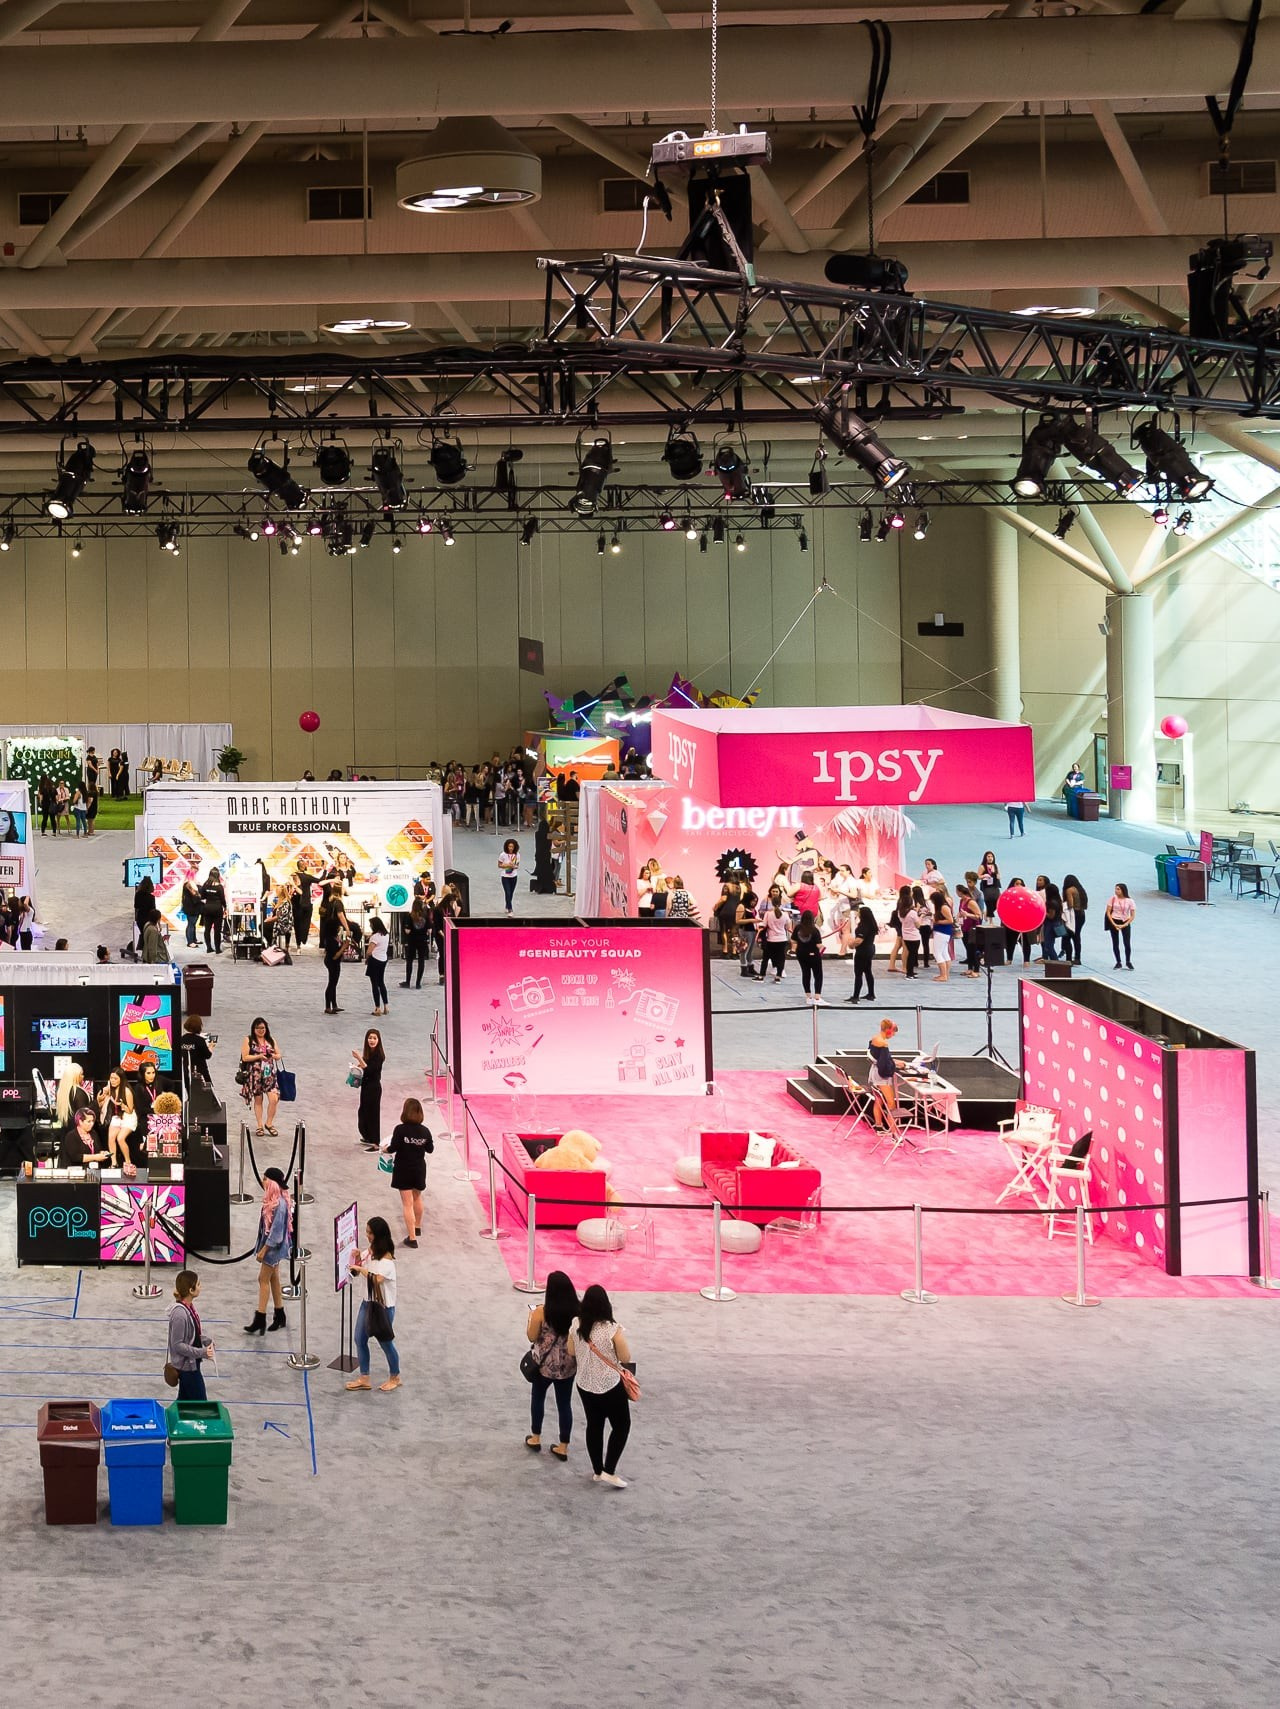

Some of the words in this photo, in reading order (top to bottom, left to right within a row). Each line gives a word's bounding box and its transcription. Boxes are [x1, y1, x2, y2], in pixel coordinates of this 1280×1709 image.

[15, 749, 72, 760] COVERGIRL
[668, 732, 697, 789] ipsy
[812, 748, 944, 802] ipsy
[227, 796, 269, 815] MARC
[280, 796, 350, 815] ANTHONY
[237, 823, 261, 831] TRUE
[266, 823, 342, 832] PROFESSIONAL
[549, 939, 577, 947] SNAP
[581, 939, 610, 947] YOUR
[519, 949, 597, 958] #GENBEAUTY
[601, 949, 642, 958] SQUAD
[482, 1056, 526, 1071] FLAWLESS
[655, 1052, 683, 1070] SLAY
[653, 1070, 673, 1086] ALL
[674, 1064, 696, 1081] DAY
[2, 1089, 19, 1099] pop
[155, 1117, 173, 1126] pop
[29, 1206, 88, 1238] pop
[74, 1229, 97, 1239] beauty
